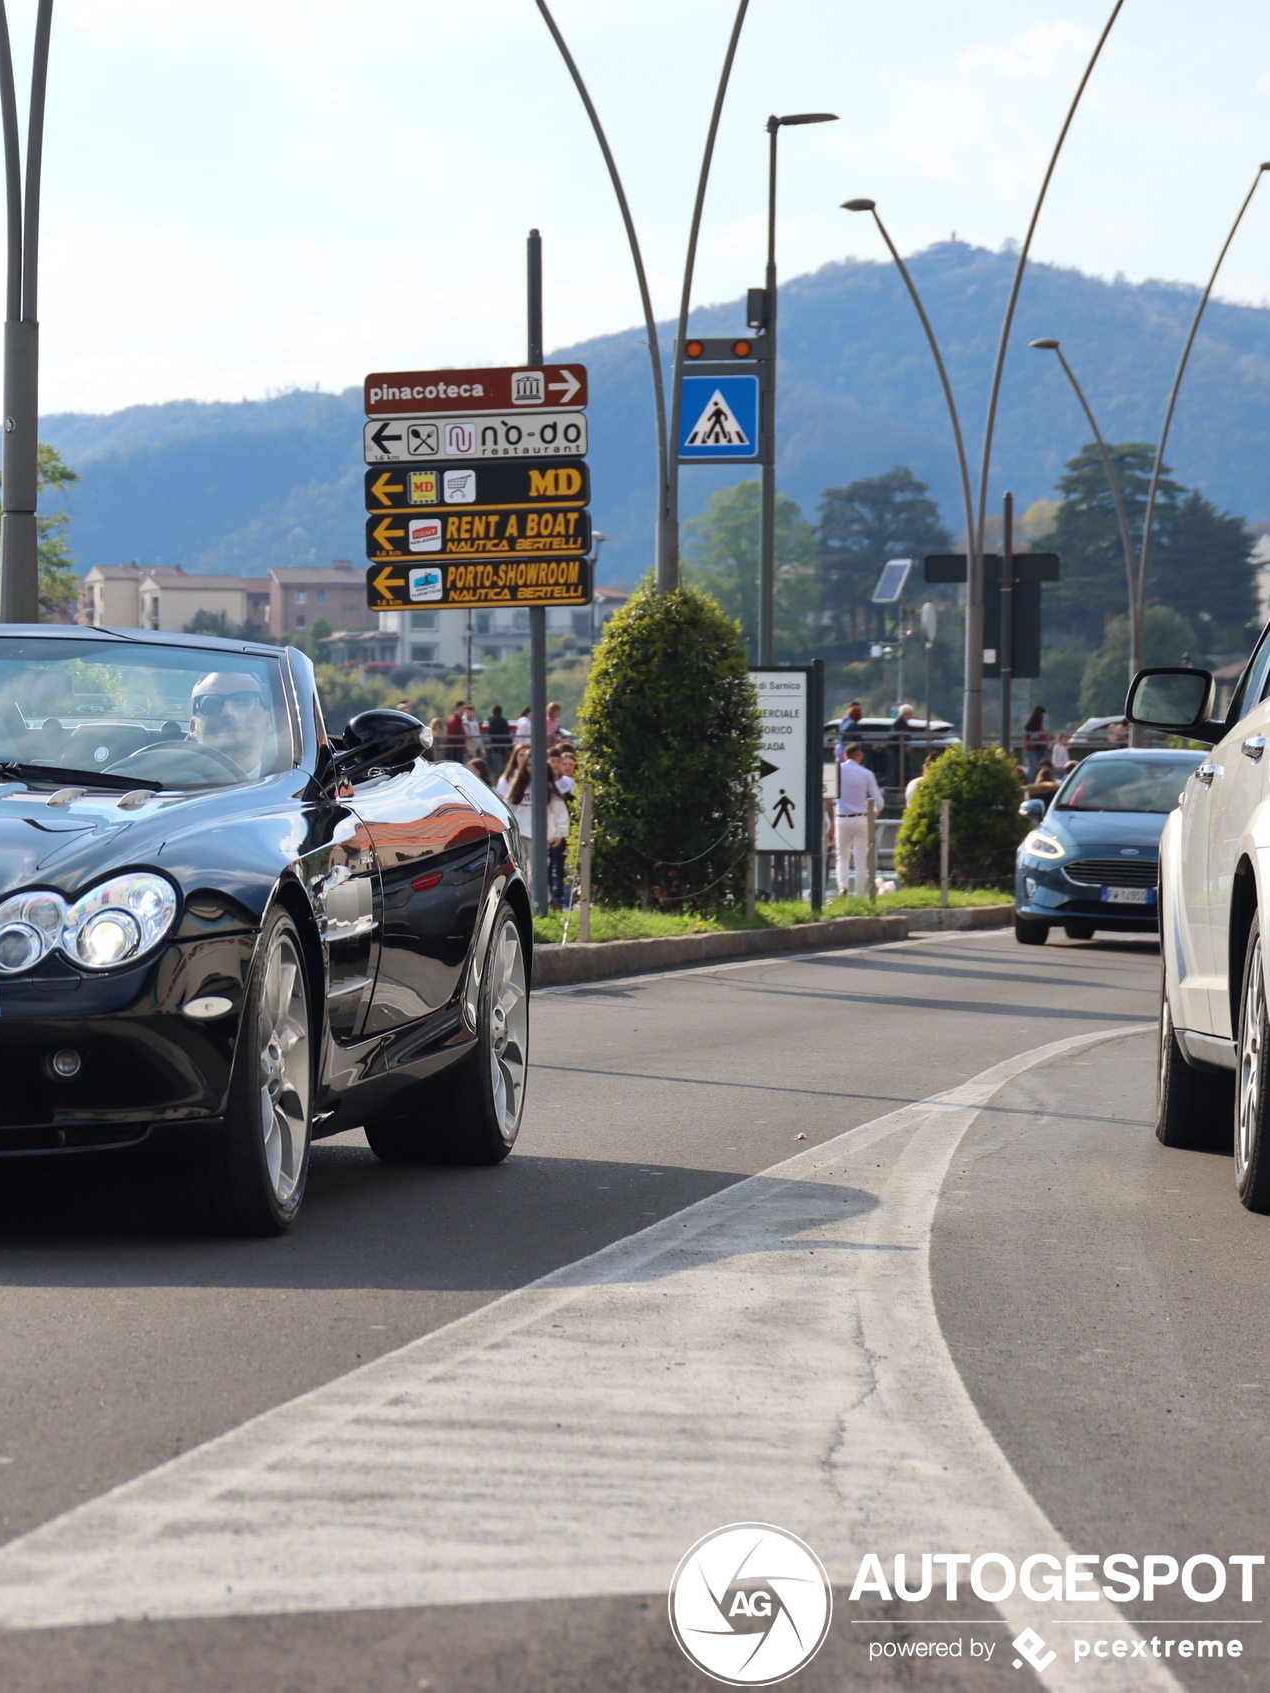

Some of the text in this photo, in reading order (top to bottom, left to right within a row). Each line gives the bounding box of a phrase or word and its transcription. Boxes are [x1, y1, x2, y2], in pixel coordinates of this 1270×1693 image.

[370, 381, 484, 404] pinacoteca
[482, 444, 581, 455] restaurant
[413, 481, 434, 493] MD
[528, 468, 582, 497] MD
[413, 528, 437, 538] RENT
[446, 512, 580, 539] RENT A BOAT
[446, 537, 582, 552] NAUTICA BERTELLI
[446, 561, 580, 588] PORTO-SHOWROOM
[449, 585, 583, 601] NAUTICA BERTELLI
[769, 682, 801, 690] Sarnico
